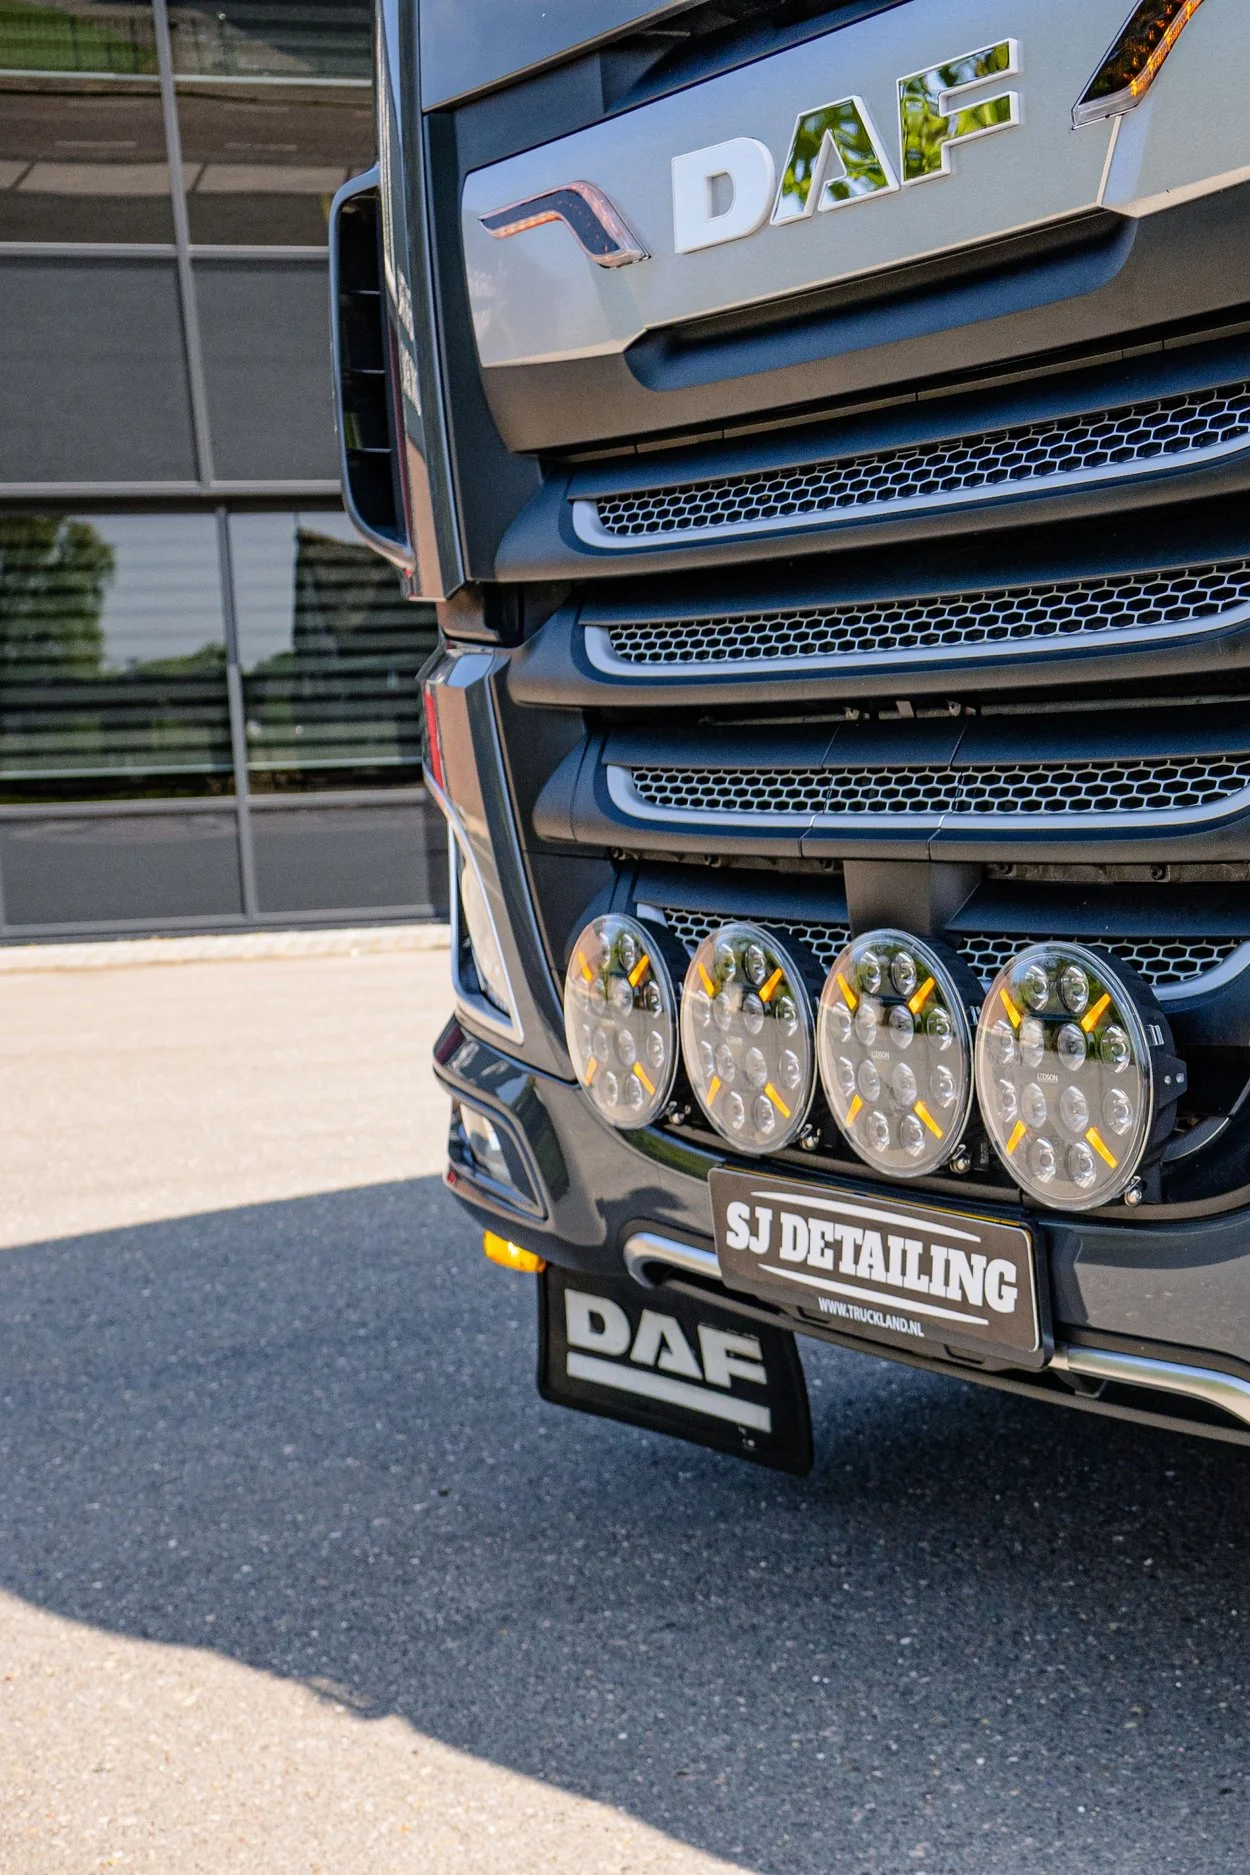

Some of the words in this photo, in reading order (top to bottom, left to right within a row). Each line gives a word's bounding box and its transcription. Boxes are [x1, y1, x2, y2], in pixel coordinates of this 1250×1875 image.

[672, 38, 1021, 254] DAF
[725, 1200, 774, 1256] SJ
[779, 1212, 1019, 1314] DETAILING
[564, 1288, 768, 1389] DAF
[817, 1296, 926, 1338] WWW.TRUCKLAND.NL
